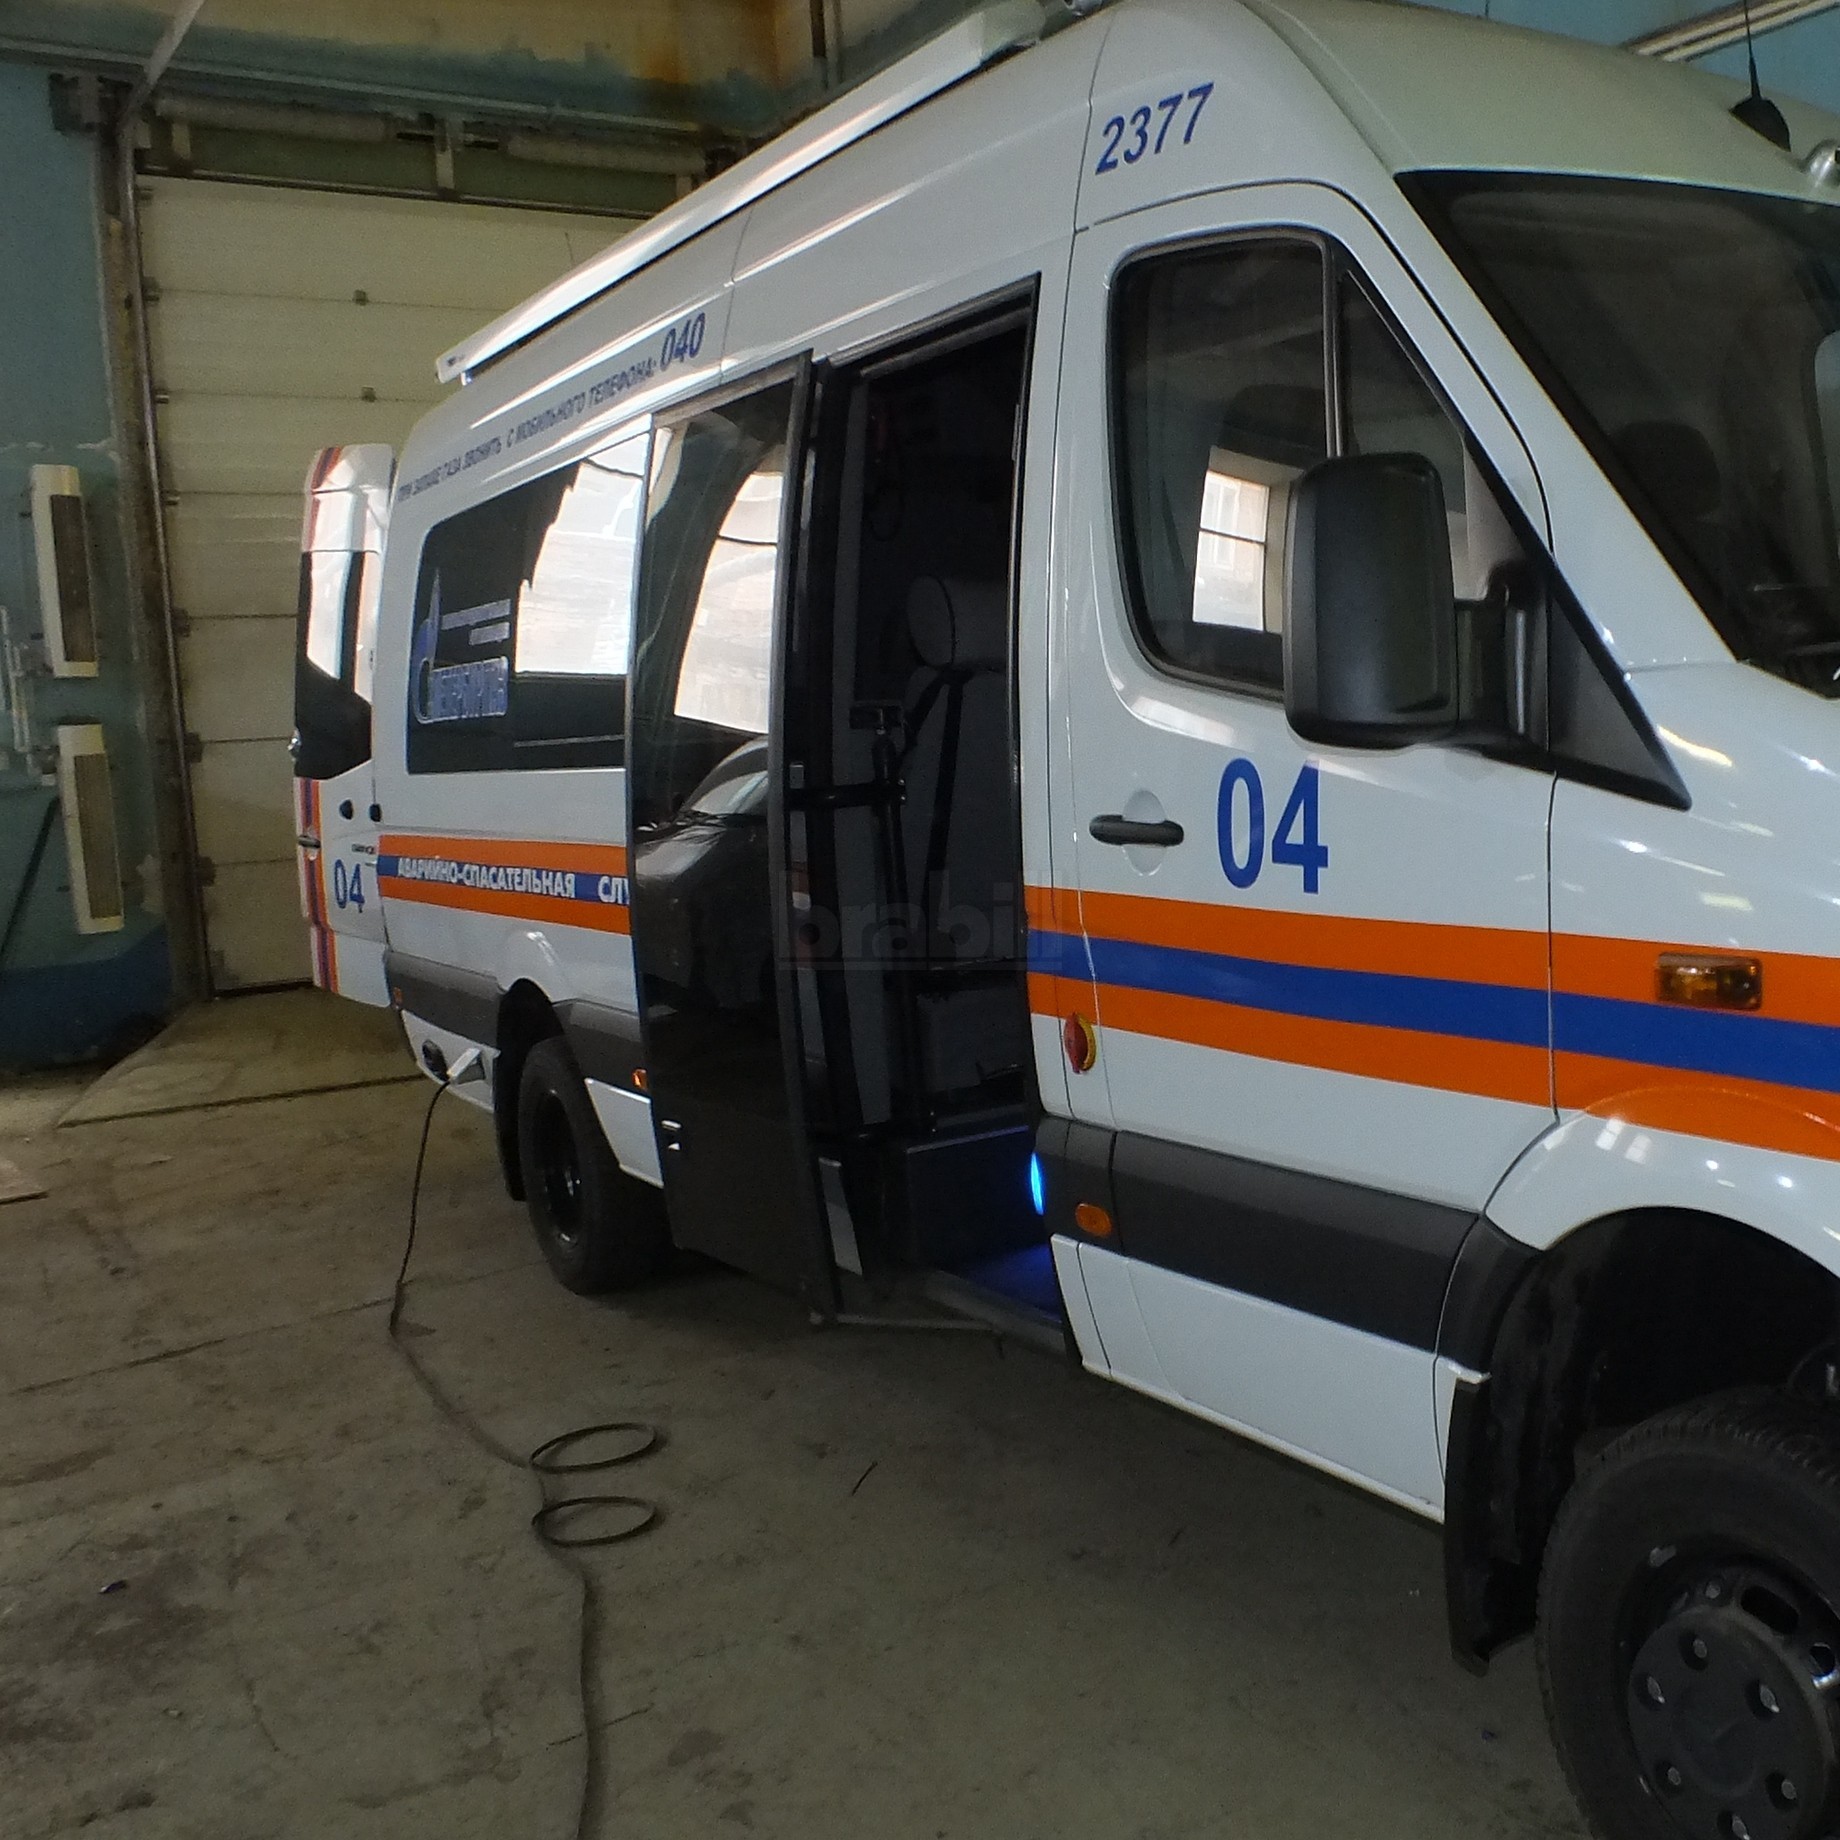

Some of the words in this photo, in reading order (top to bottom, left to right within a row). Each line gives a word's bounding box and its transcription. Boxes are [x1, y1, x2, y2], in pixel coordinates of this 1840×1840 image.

[1095, 81, 1214, 175] 2377
[660, 313, 706, 372] 040
[1217, 758, 1329, 894] 04
[334, 859, 365, 913] 04
[398, 856, 576, 898] АВАРИЙНО-СПАСАТЕЛЬНАЯ
